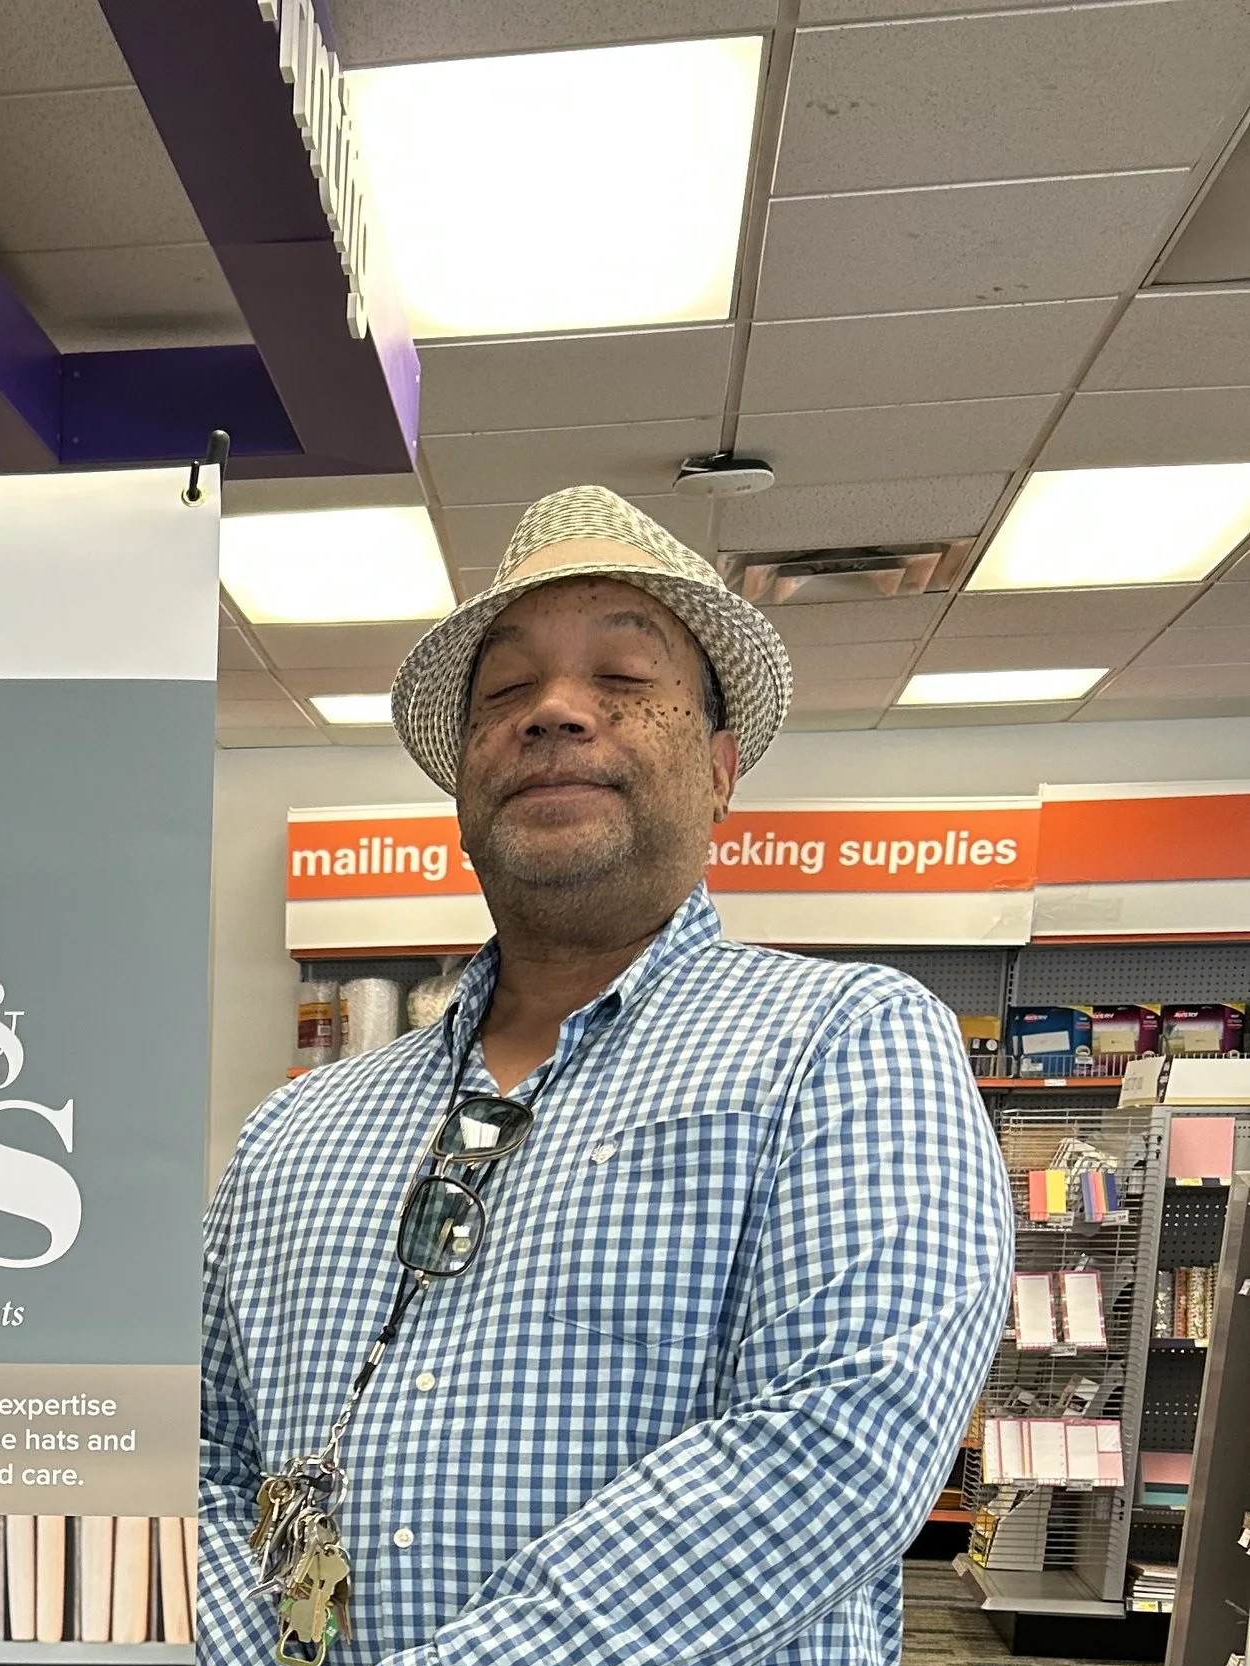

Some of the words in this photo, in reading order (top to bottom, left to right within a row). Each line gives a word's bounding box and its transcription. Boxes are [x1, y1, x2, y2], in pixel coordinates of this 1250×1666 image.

[291, 836, 448, 882] mailing
[838, 831, 1018, 875] supplies
[25, 1428, 80, 1451] hats
[87, 1429, 136, 1452] and
[21, 1468, 84, 1486] care.
